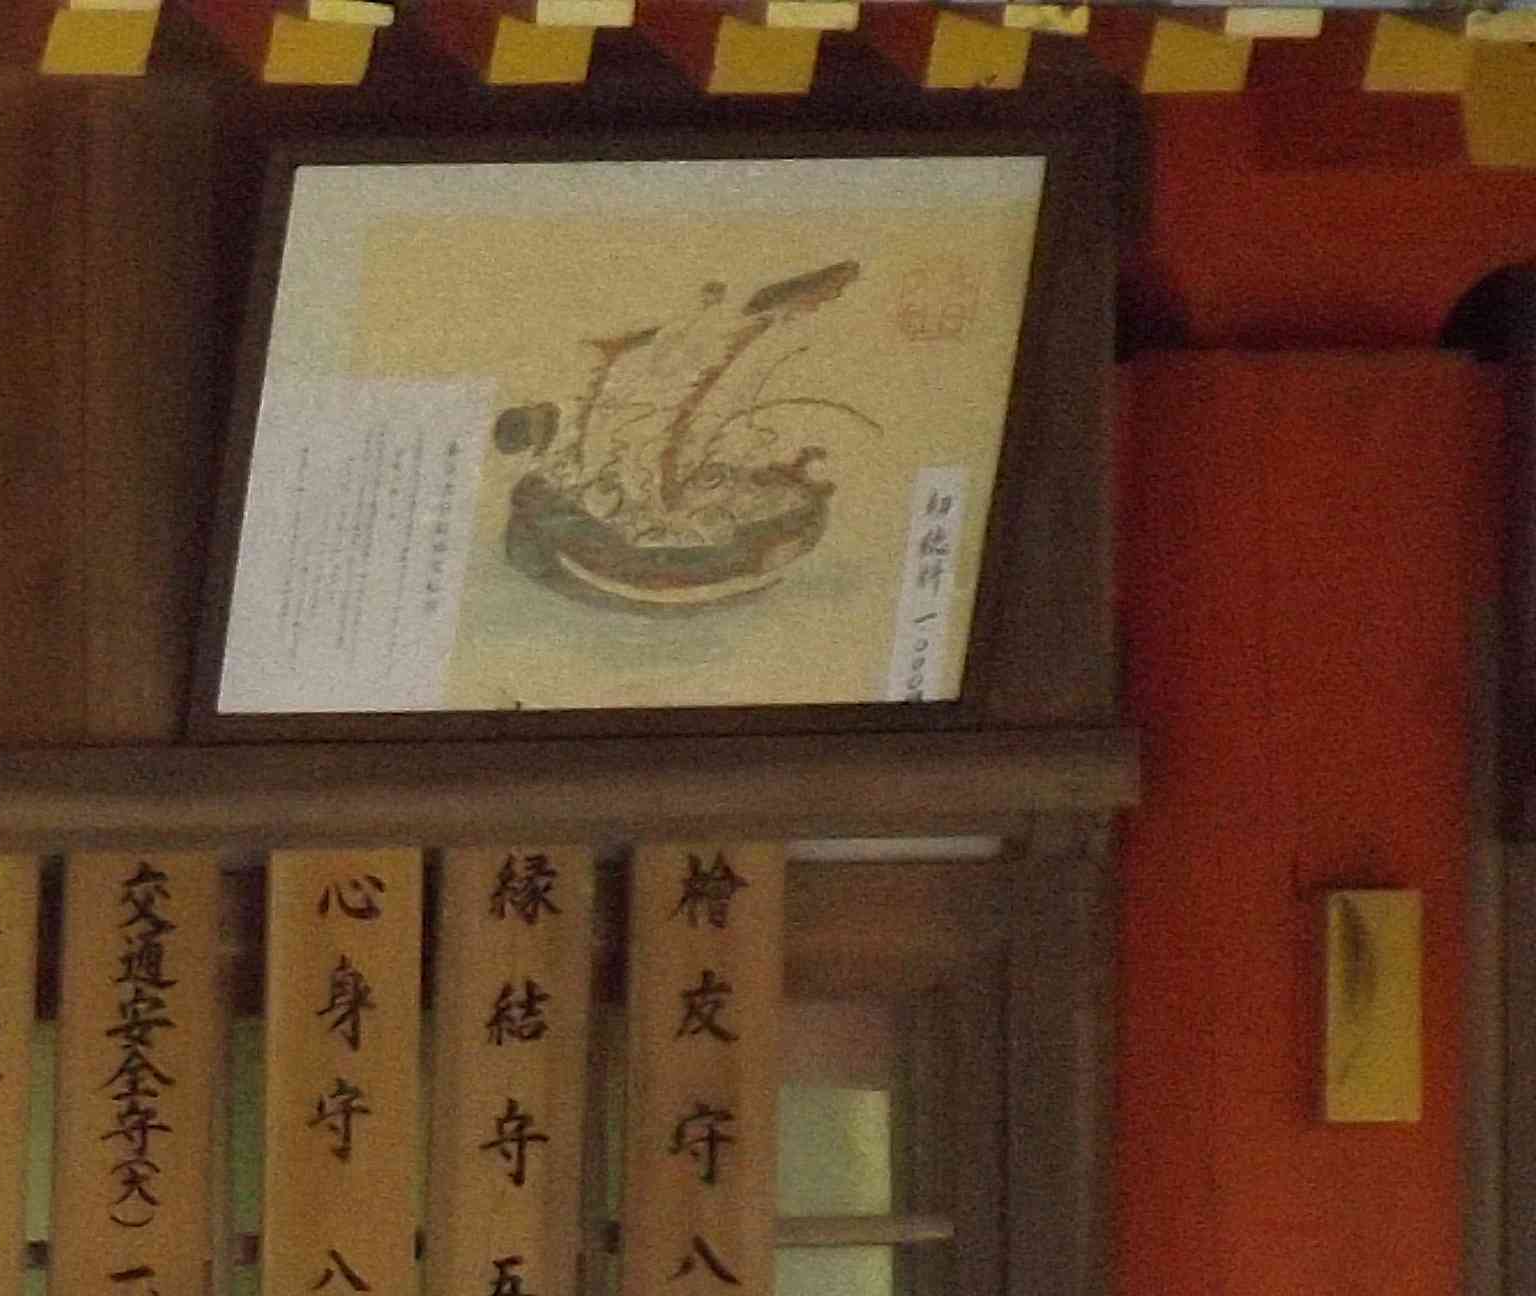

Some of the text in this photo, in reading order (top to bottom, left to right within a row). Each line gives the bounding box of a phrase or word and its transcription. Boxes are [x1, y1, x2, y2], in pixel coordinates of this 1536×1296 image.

[307, 873, 386, 1163] 心身守
[479, 852, 564, 1188] 縁結守
